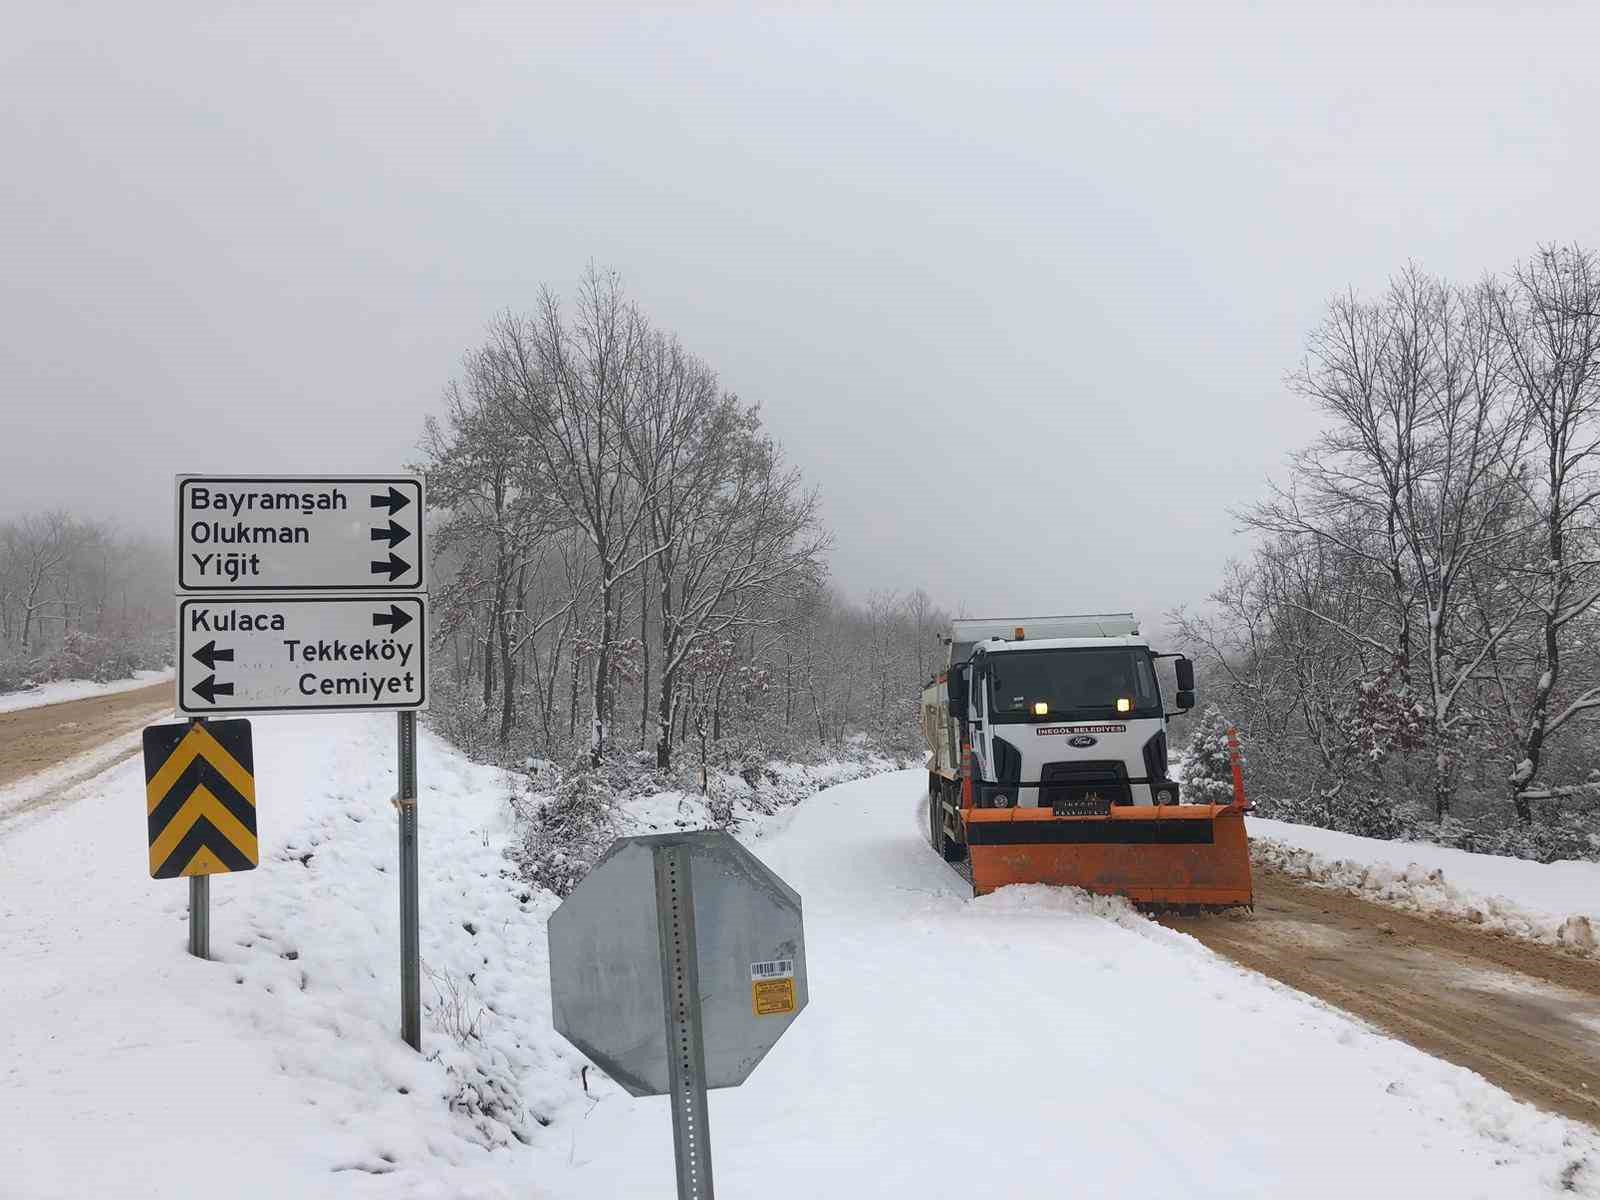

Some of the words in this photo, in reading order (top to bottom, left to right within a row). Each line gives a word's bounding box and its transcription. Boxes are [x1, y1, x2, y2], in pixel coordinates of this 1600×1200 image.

[191, 488, 347, 517] Bayramşah
[191, 521, 310, 544] Olukman
[192, 553, 260, 582] Yiğit
[191, 609, 285, 632] Kulaca
[284, 639, 413, 667] Tekkeköy
[299, 672, 414, 701] Cemiyet
